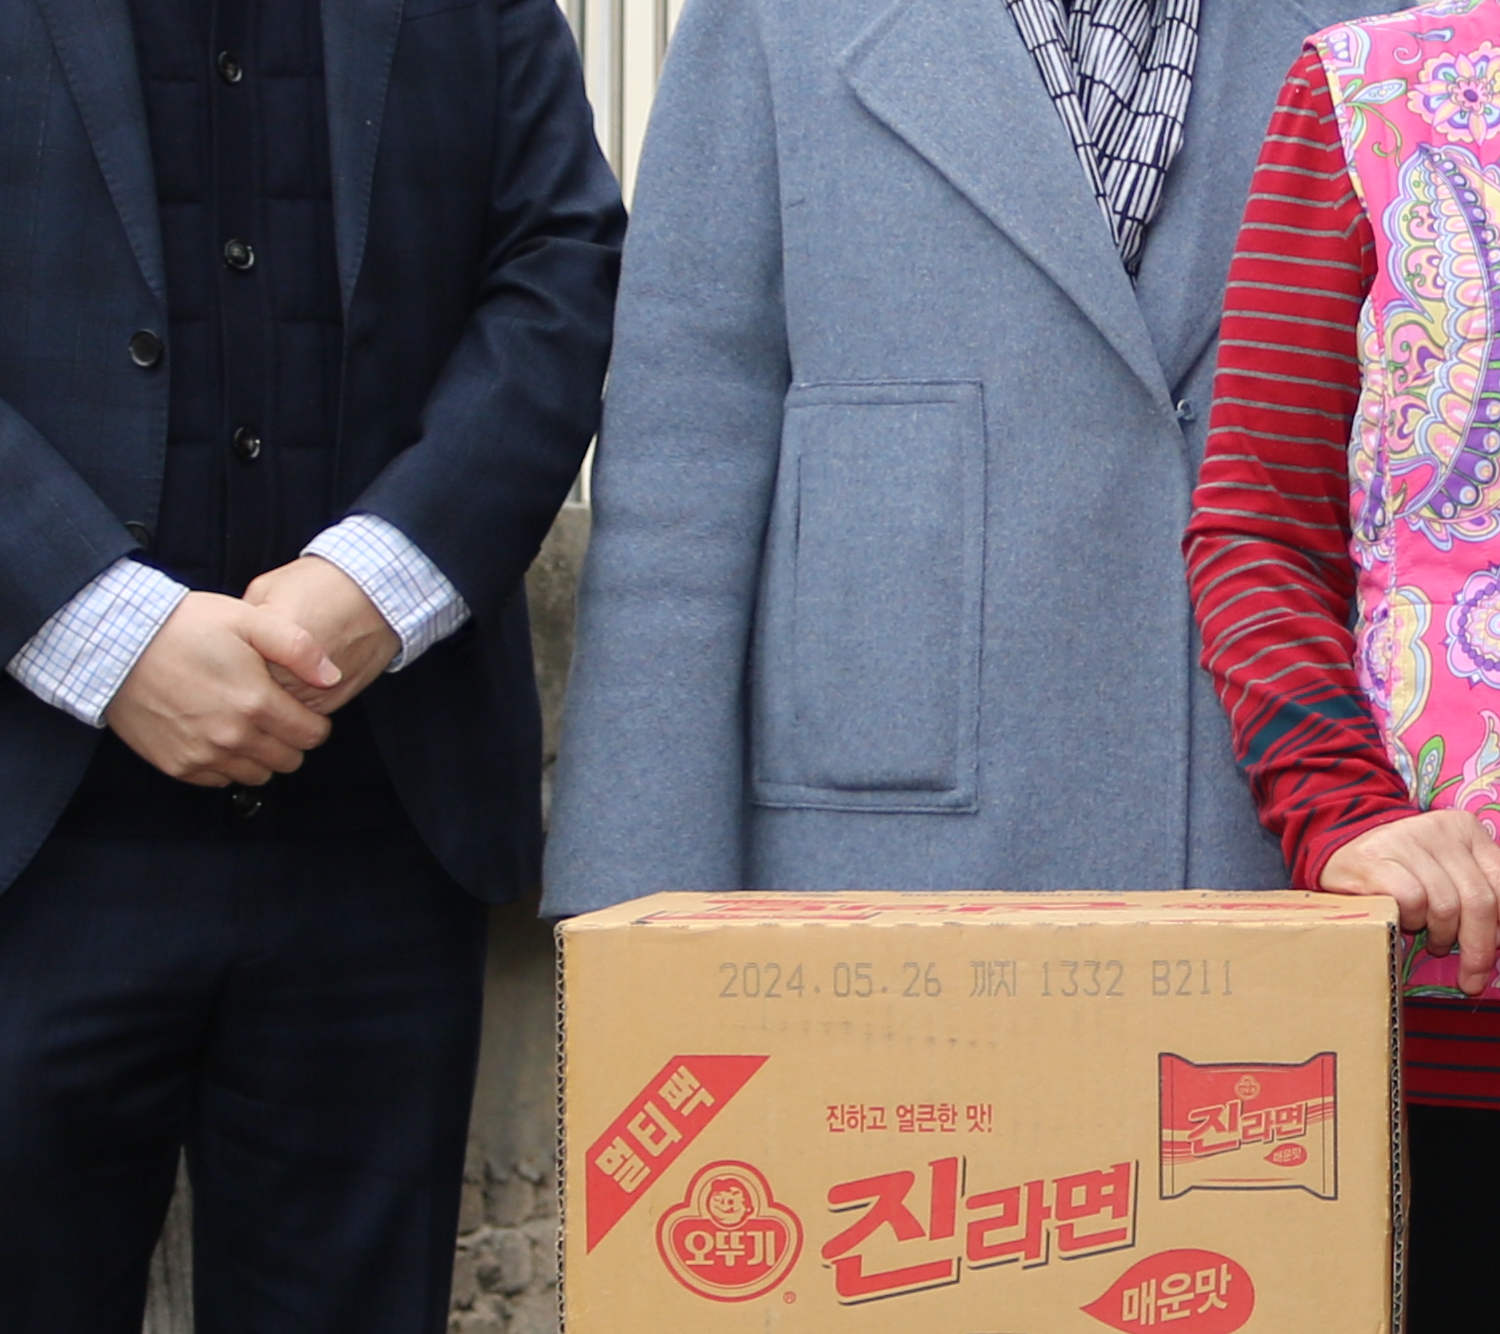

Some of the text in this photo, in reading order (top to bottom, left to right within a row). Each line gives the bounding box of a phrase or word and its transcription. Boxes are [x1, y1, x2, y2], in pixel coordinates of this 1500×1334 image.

[719, 962, 942, 998] 2024.05.26
[1041, 960, 1124, 996] 1332
[1152, 959, 1233, 996] B211
[597, 1067, 714, 1191] 멀티팩
[827, 1103, 991, 1132] 진하고 얼큰한 맛!
[1186, 1098, 1309, 1160] 진라면
[684, 1230, 777, 1267] 오뚜기
[821, 1155, 1141, 1308] 진라면
[1119, 1261, 1231, 1323] 매운맛
